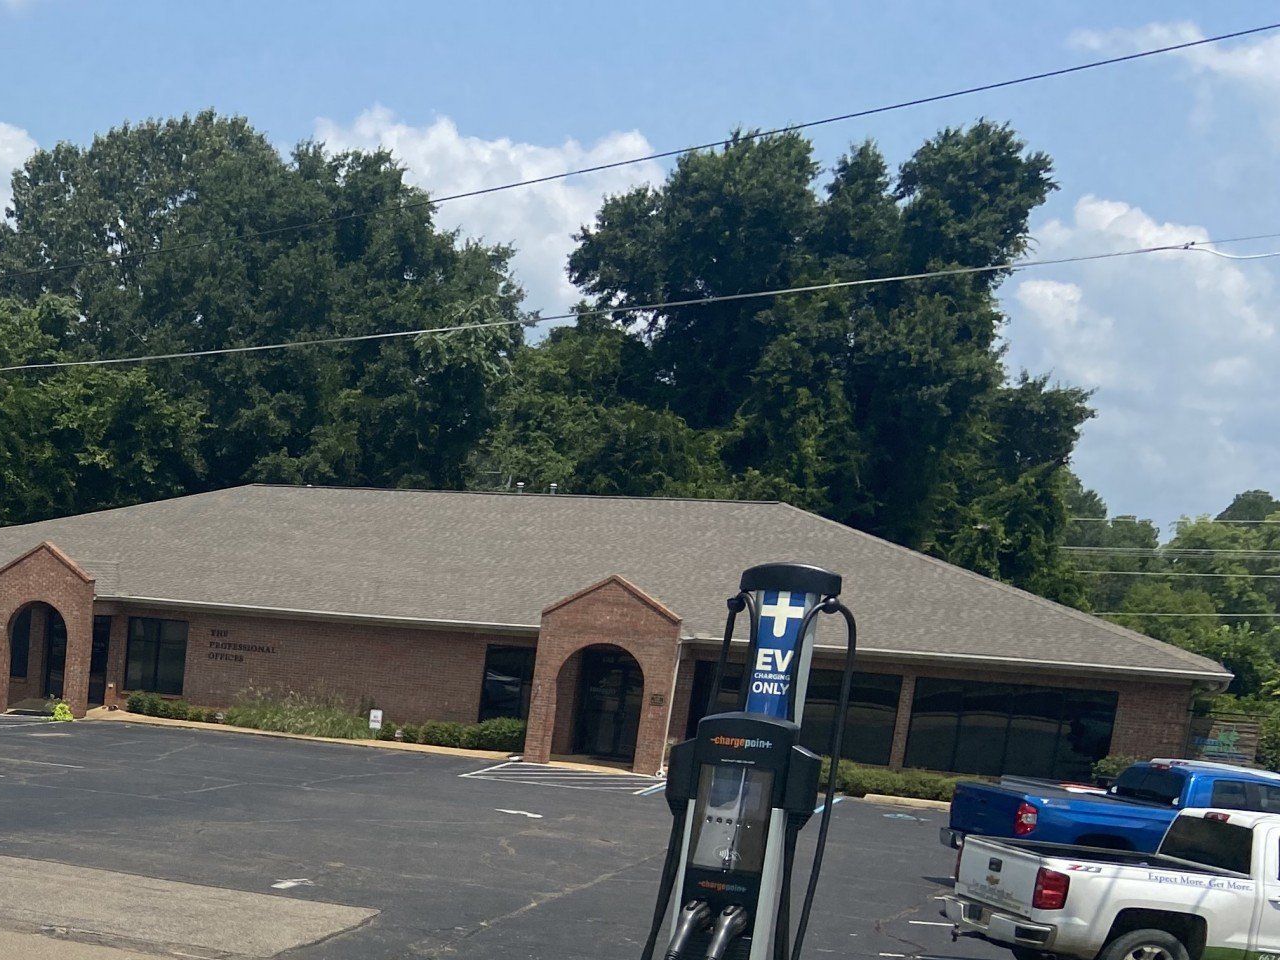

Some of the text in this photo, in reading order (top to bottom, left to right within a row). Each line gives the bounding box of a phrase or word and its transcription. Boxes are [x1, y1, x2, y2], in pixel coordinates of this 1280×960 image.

[210, 629, 228, 637] THE
[209, 641, 276, 654] PROFESSIONAL
[208, 652, 244, 662] OFFICES
[755, 648, 794, 672] EV
[754, 672, 790, 681] CHARGING
[752, 681, 790, 696] ONLY
[1148, 872, 1253, 891] Expect More. Get More.
